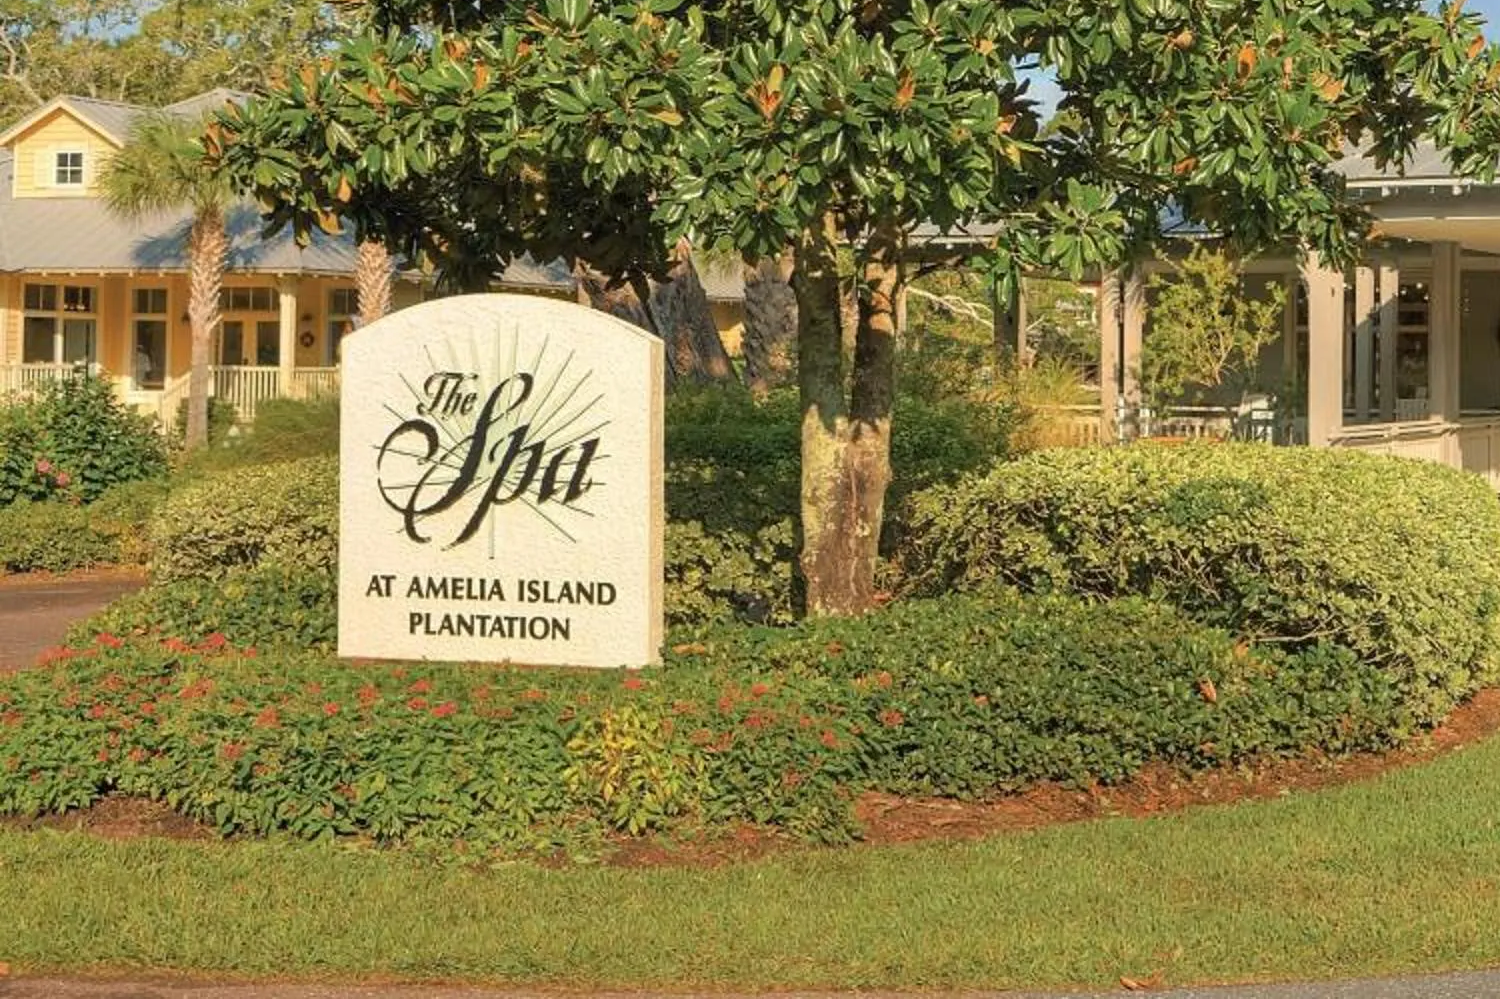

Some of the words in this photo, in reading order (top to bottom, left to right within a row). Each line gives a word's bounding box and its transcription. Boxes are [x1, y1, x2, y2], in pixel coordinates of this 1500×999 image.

[417, 372, 479, 418] The
[377, 372, 601, 551] Spa
[365, 575, 397, 598] AT
[406, 575, 506, 602] AMELIA
[517, 579, 617, 606] ISLAND
[408, 611, 571, 641] PLANTATION
